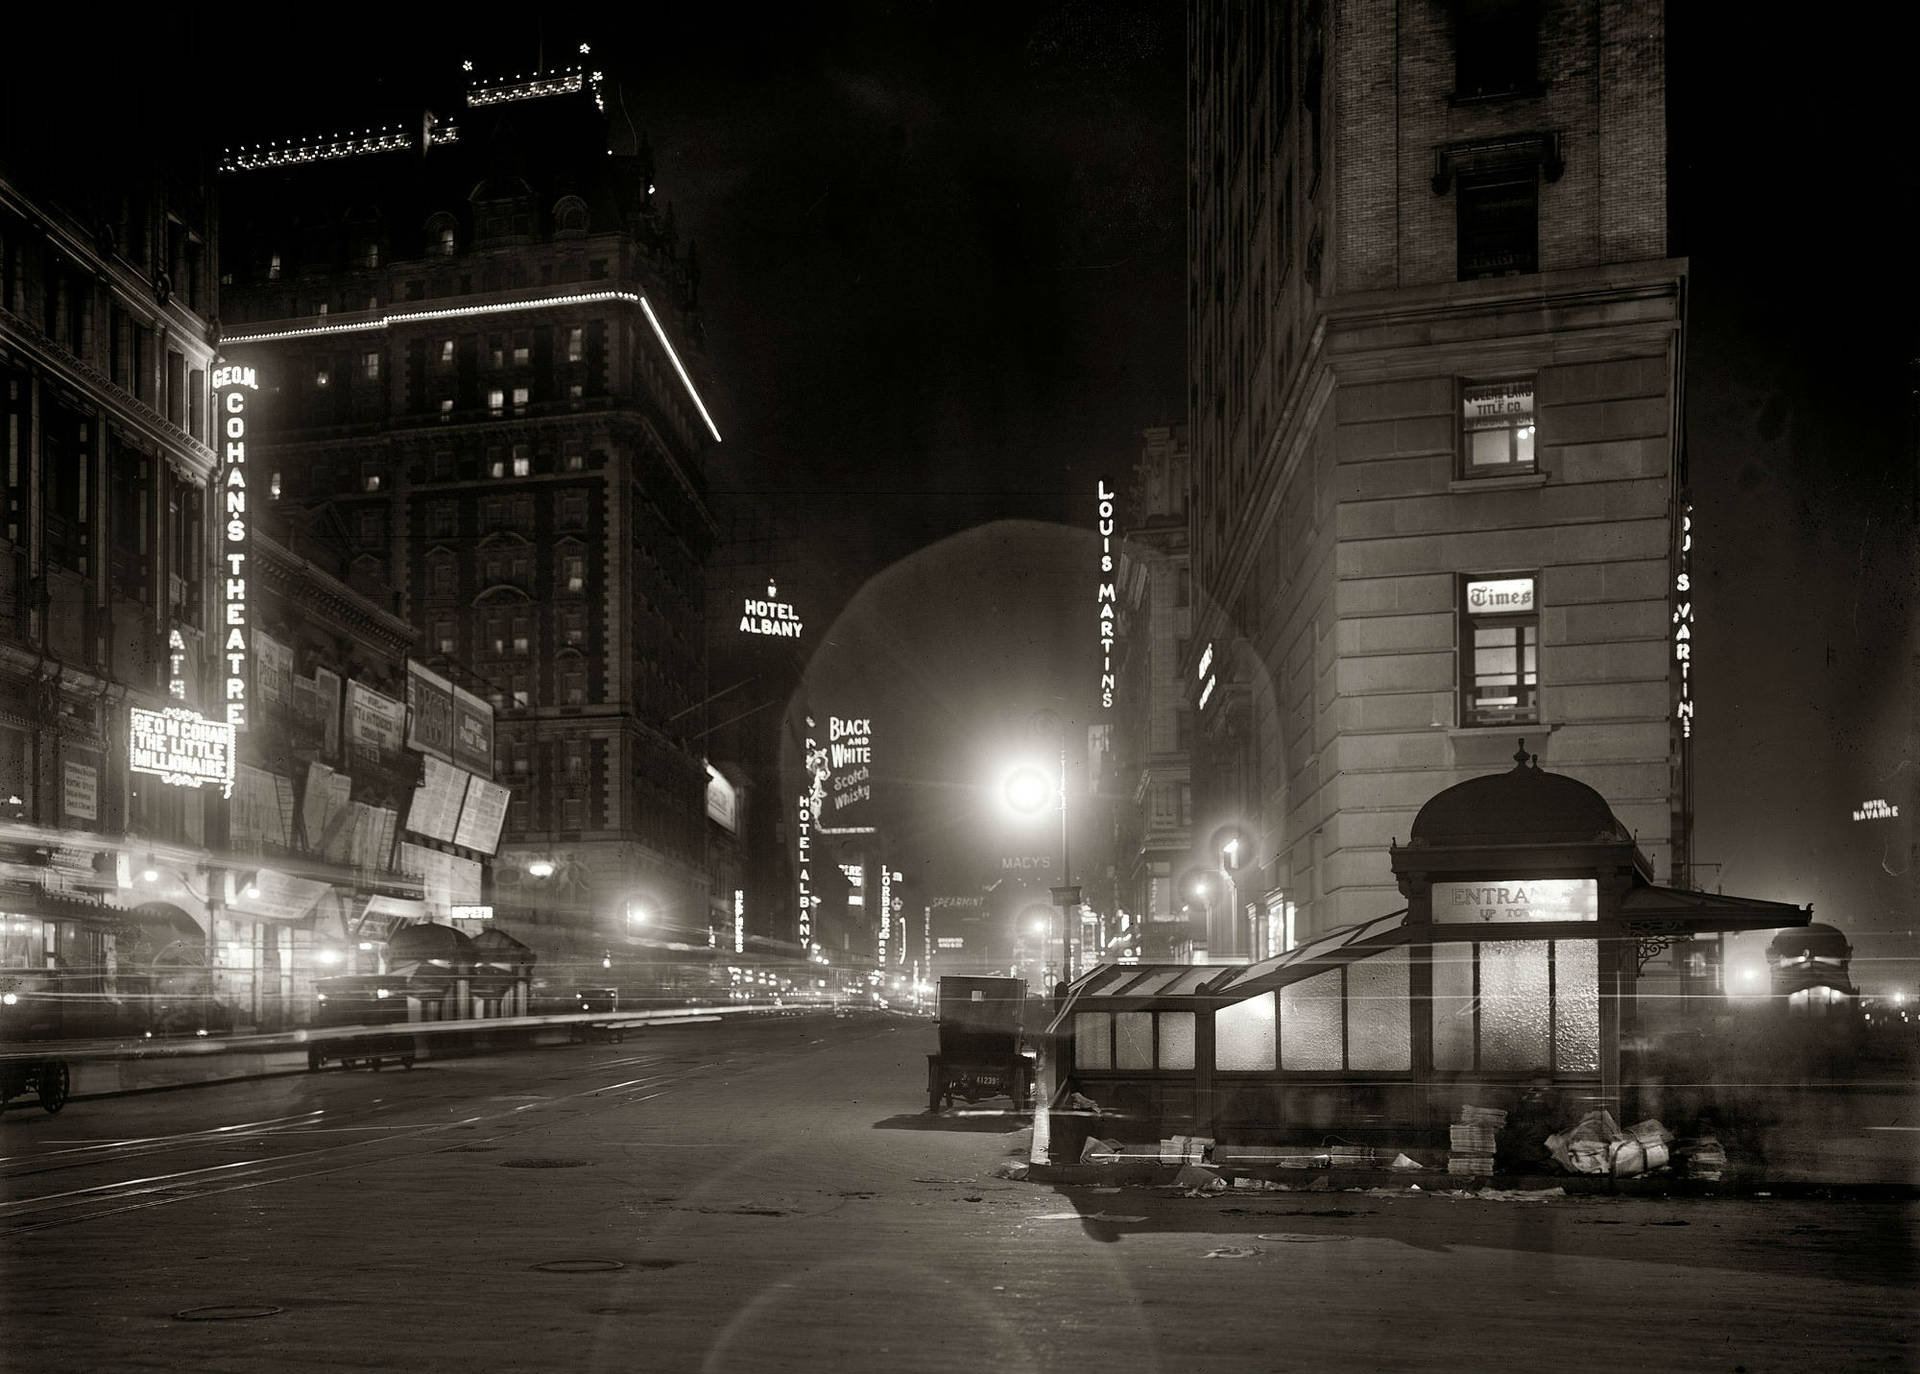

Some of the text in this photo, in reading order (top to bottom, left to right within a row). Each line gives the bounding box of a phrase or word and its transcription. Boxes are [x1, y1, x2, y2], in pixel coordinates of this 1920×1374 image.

[1477, 403, 1504, 416] TITLE
[1098, 480, 1114, 571] LOUIS
[1471, 586, 1532, 606] Times
[745, 599, 799, 620] HOTEL
[226, 553, 246, 725] THEATRE
[740, 616, 803, 638] ALBANY
[1098, 583, 1116, 707] MARTIN'S
[830, 717, 871, 741] BLACK
[847, 737, 869, 745] AND
[136, 732, 225, 761] THE LITTLE
[831, 744, 871, 768] WHITE
[135, 749, 226, 777] MILLIONAIRE
[833, 766, 869, 790] Scotch
[834, 785, 870, 810] Whisky
[1863, 799, 1888, 810] HOTEL
[1853, 805, 1899, 822] NAVARRE
[800, 796, 810, 949] HOTEL ALBANY
[1451, 886, 1572, 906] ENTRA
